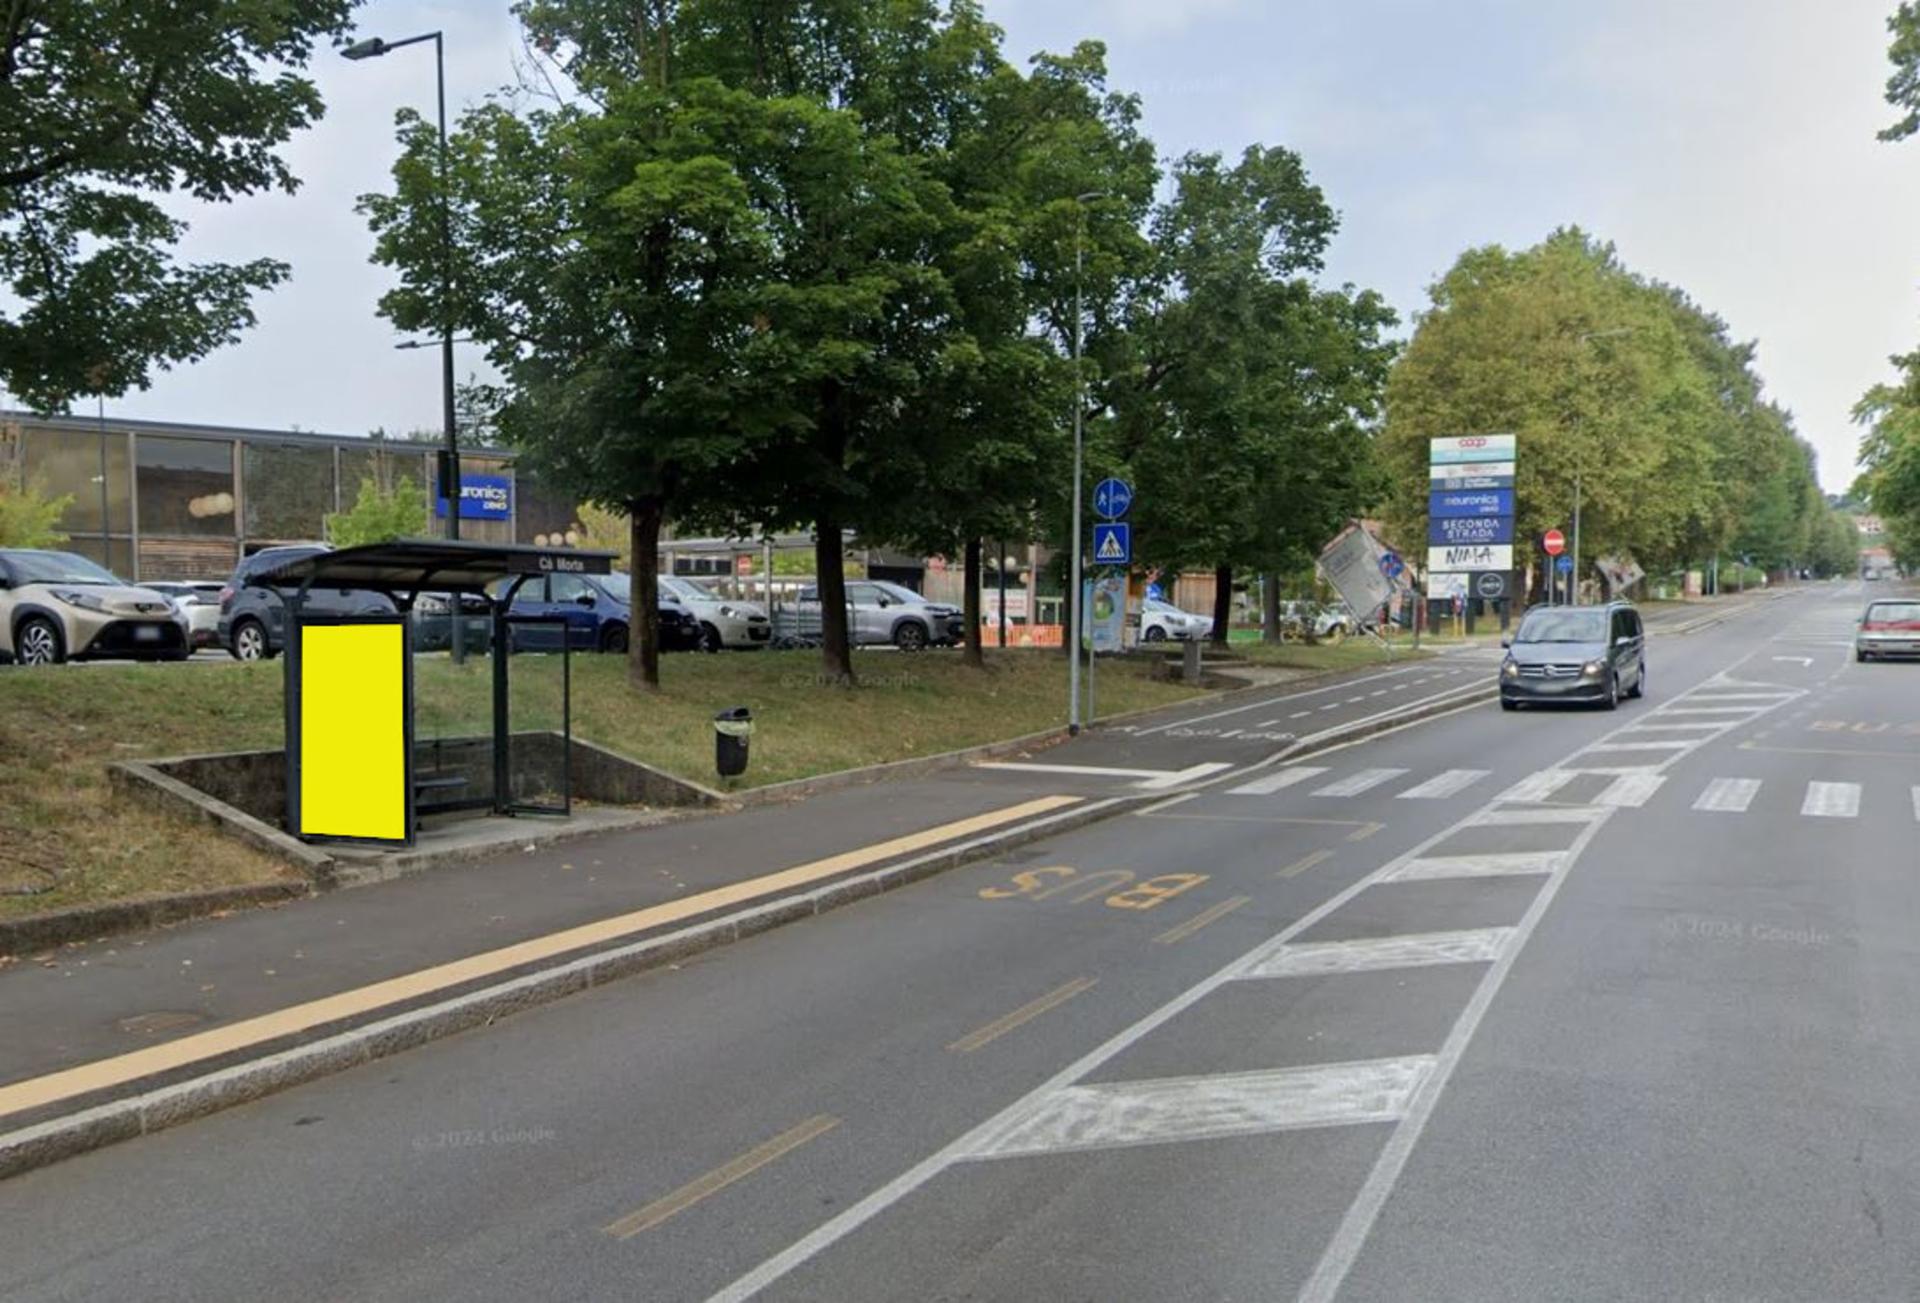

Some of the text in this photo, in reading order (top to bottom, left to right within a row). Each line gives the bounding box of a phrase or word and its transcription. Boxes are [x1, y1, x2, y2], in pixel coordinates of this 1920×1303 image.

[1442, 518, 1500, 530] SECONDA
[1447, 528, 1495, 539] STRADA
[1445, 546, 1495, 565] NIMA
[978, 865, 1211, 910] BUS
